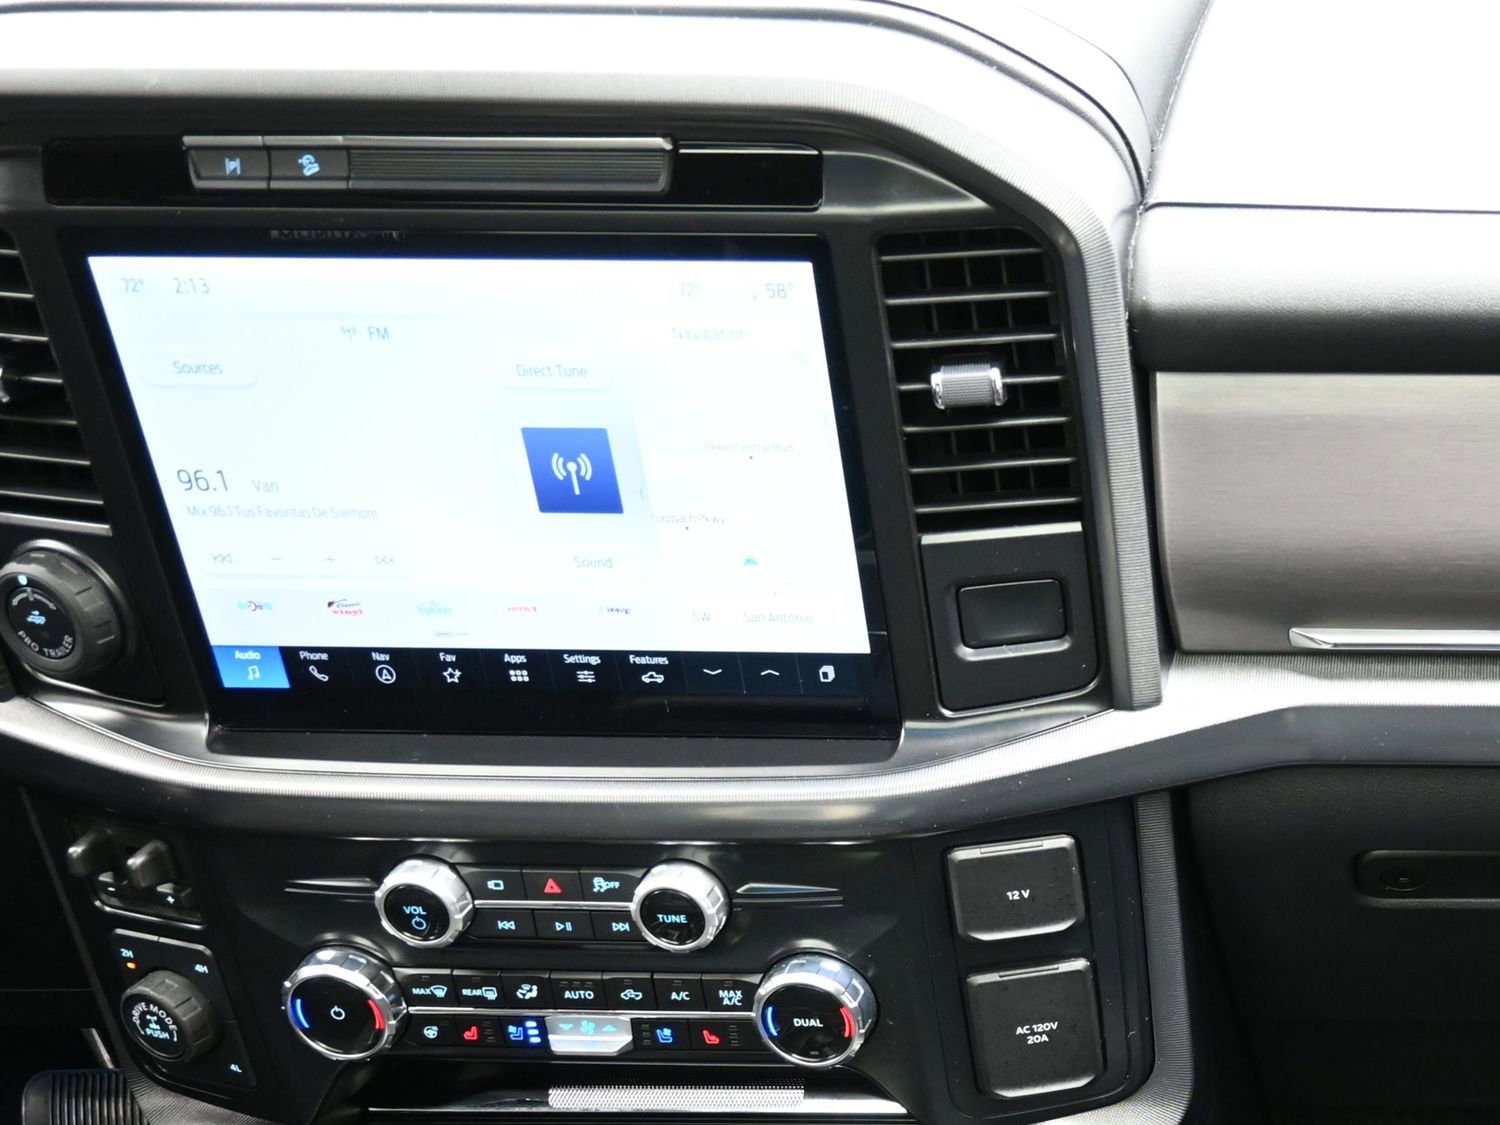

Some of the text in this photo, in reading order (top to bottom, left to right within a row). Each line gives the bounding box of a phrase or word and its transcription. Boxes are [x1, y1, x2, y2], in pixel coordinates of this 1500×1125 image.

[173, 276, 212, 296] 2:13
[765, 282, 795, 300] 58°
[367, 326, 391, 342] FM
[672, 326, 749, 343] Navigation
[172, 360, 224, 376] Sources
[515, 363, 589, 379] Direct Tune
[175, 467, 231, 493] 96.1
[186, 505, 206, 518] Mix
[572, 555, 613, 570] Sound
[690, 611, 712, 623] SW
[743, 610, 814, 623] San Antonio
[17, 630, 74, 658] PRO TRAILER
[234, 650, 261, 661] Audio
[299, 651, 329, 661] Phone
[371, 652, 390, 661] Nav
[439, 653, 456, 662] Fav
[504, 653, 528, 665] Apps
[562, 653, 601, 666] Settings
[629, 654, 669, 665] Features
[605, 880, 620, 889] OFF
[1006, 889, 1030, 901] 12 V
[403, 905, 427, 916] VOL
[656, 914, 688, 924] TUNE
[120, 948, 134, 958] 2H
[194, 963, 209, 974] 4H
[412, 987, 431, 996] MAX
[462, 988, 483, 997] REAR
[564, 990, 594, 1000] AUTO
[670, 991, 690, 1001] A/C
[719, 989, 743, 998] MAX
[723, 997, 742, 1006] A/C
[131, 1001, 179, 1032] DRIVE MODE
[793, 1018, 824, 1027] DUAL
[145, 1027, 170, 1040] PUSH
[1015, 1021, 1058, 1035] AC 120V
[1026, 1033, 1049, 1045] 20A
[230, 1063, 242, 1073] 4L
